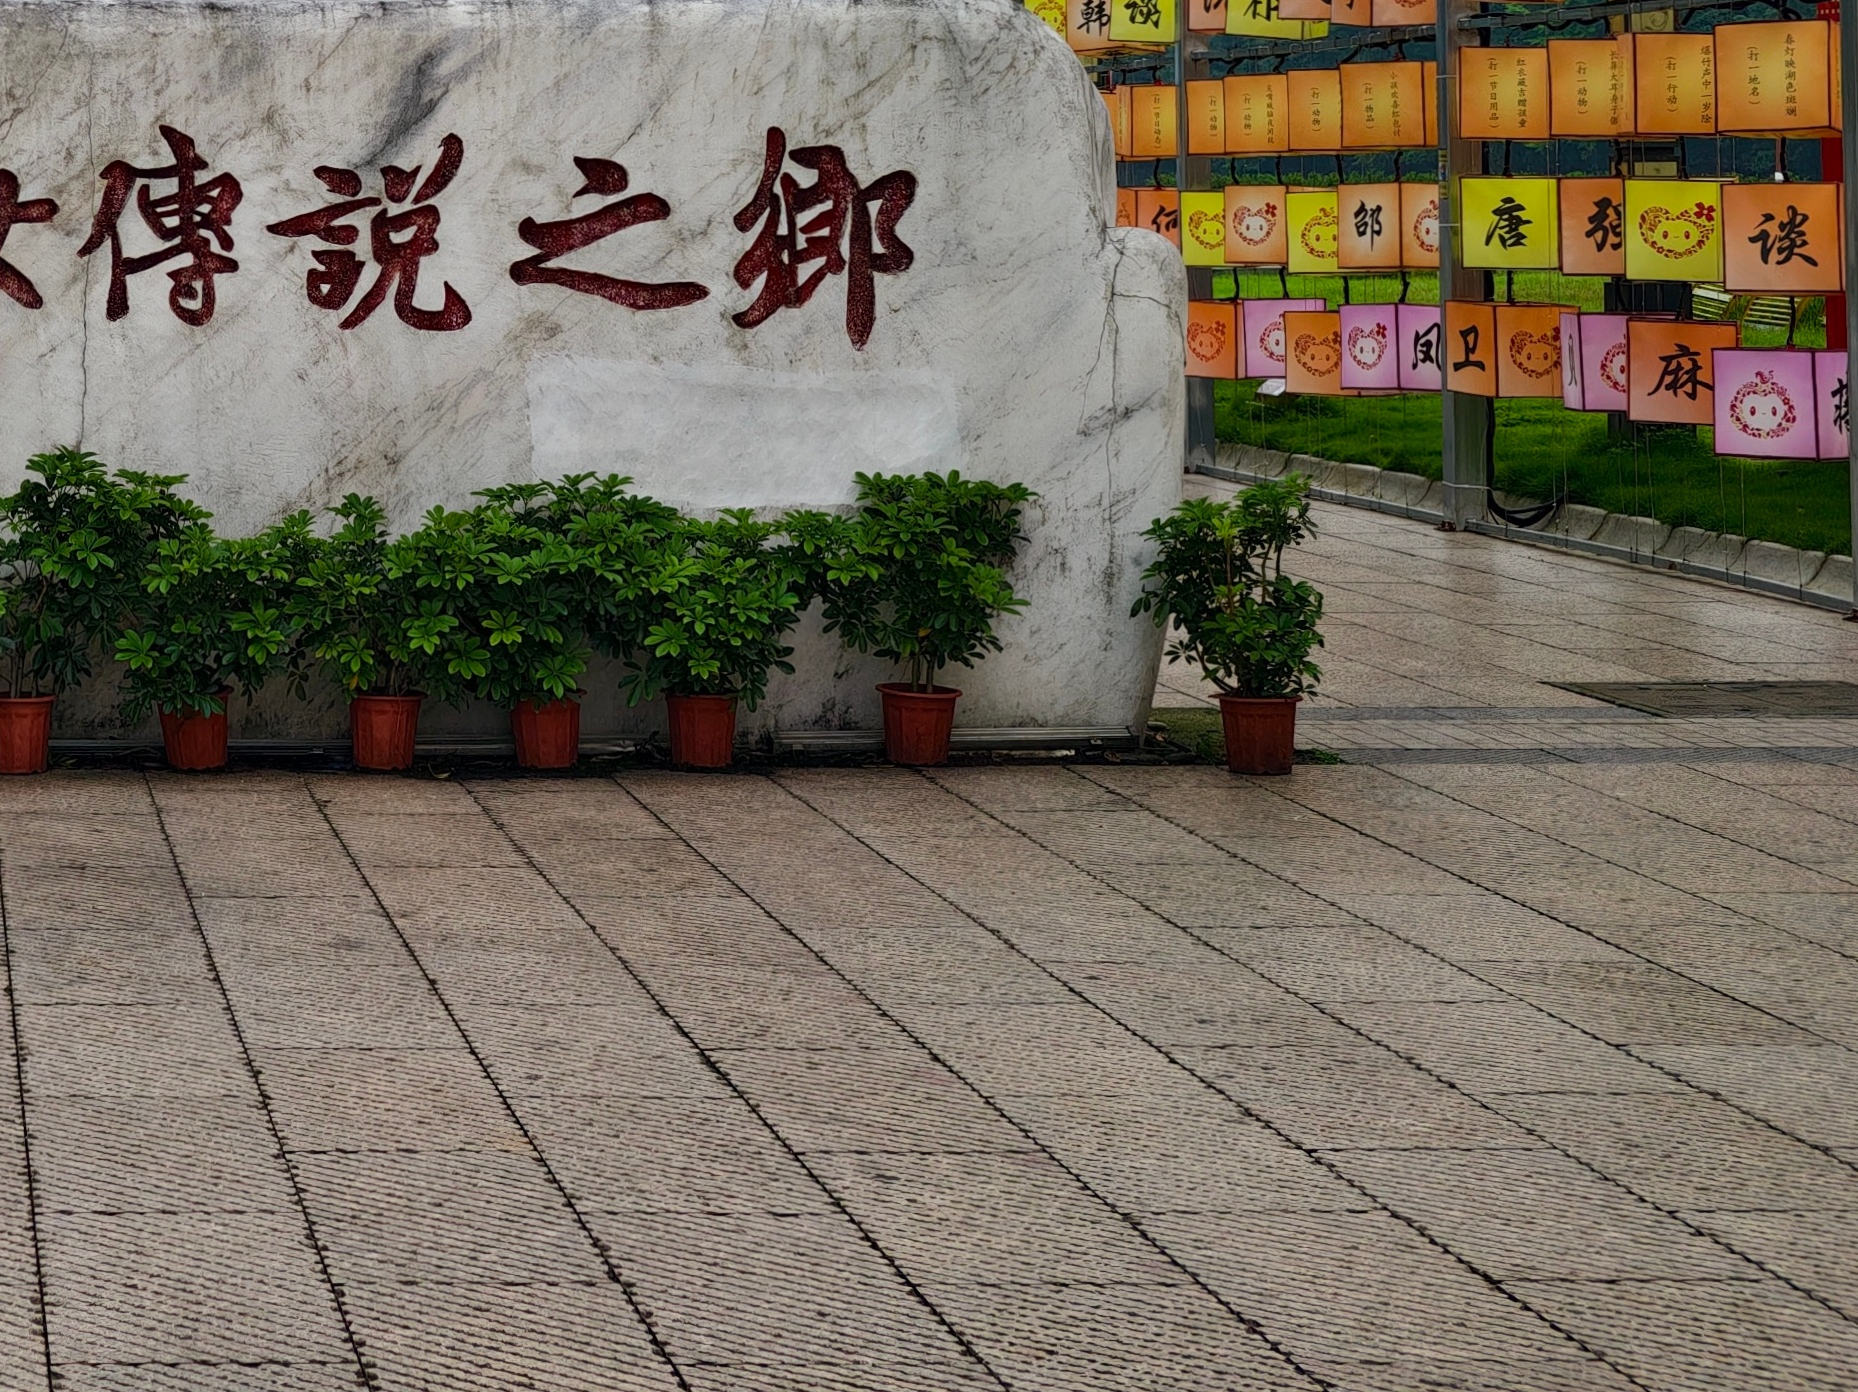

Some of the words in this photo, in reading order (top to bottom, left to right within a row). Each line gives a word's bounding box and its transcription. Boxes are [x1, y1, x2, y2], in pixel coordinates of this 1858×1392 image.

[1354, 199, 1383, 252] 邵
[1484, 197, 1534, 251] 唐
[1748, 205, 1819, 268] 谈
[1412, 323, 1442, 372] 凤
[1453, 325, 1486, 373] 卫
[1648, 343, 1714, 401] 麻
